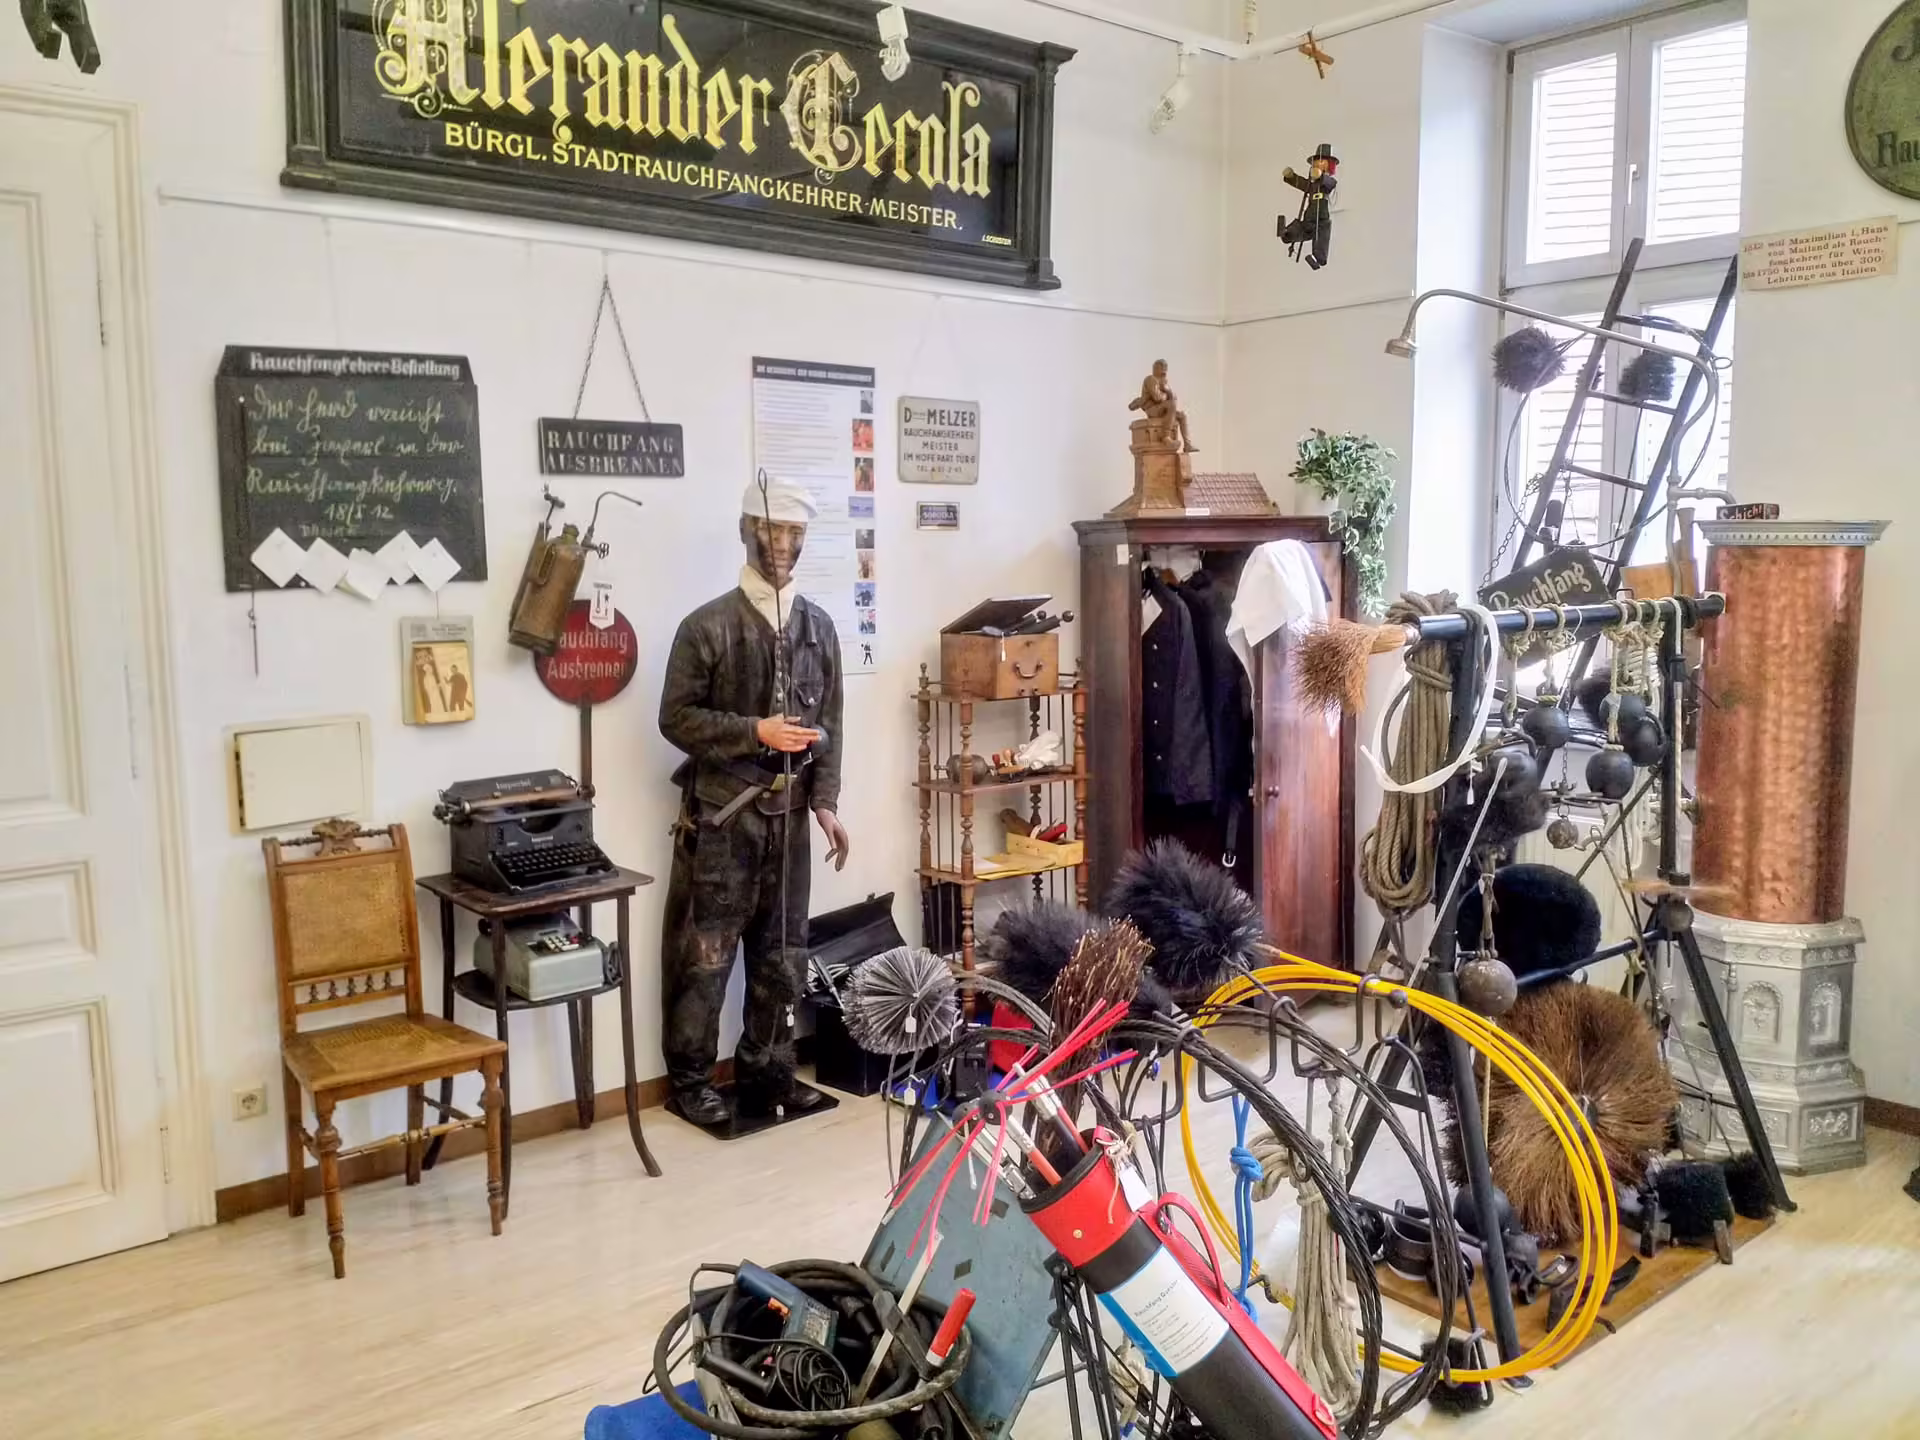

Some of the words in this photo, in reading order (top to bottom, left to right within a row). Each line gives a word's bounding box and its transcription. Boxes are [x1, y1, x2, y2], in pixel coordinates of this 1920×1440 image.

[445, 121, 547, 161] BÜRGL.
[1789, 232, 1847, 246] Maximilian
[1861, 226, 1889, 236] Hans
[1789, 243, 1829, 254] Mailand
[1832, 241, 1846, 249] als
[1828, 251, 1845, 260] für
[1783, 263, 1827, 273] kommen
[1831, 259, 1855, 268] über
[1860, 256, 1882, 265] 300
[1767, 273, 1816, 284] Lehrlinge
[1819, 271, 1837, 279] aus
[1841, 266, 1877, 277] Italien
[927, 408, 977, 428] MELZER
[547, 430, 674, 453] RAUCHFANG
[922, 441, 959, 451] MEISTER
[547, 452, 683, 475] AUSBRENNEN
[559, 622, 628, 655] auchfang
